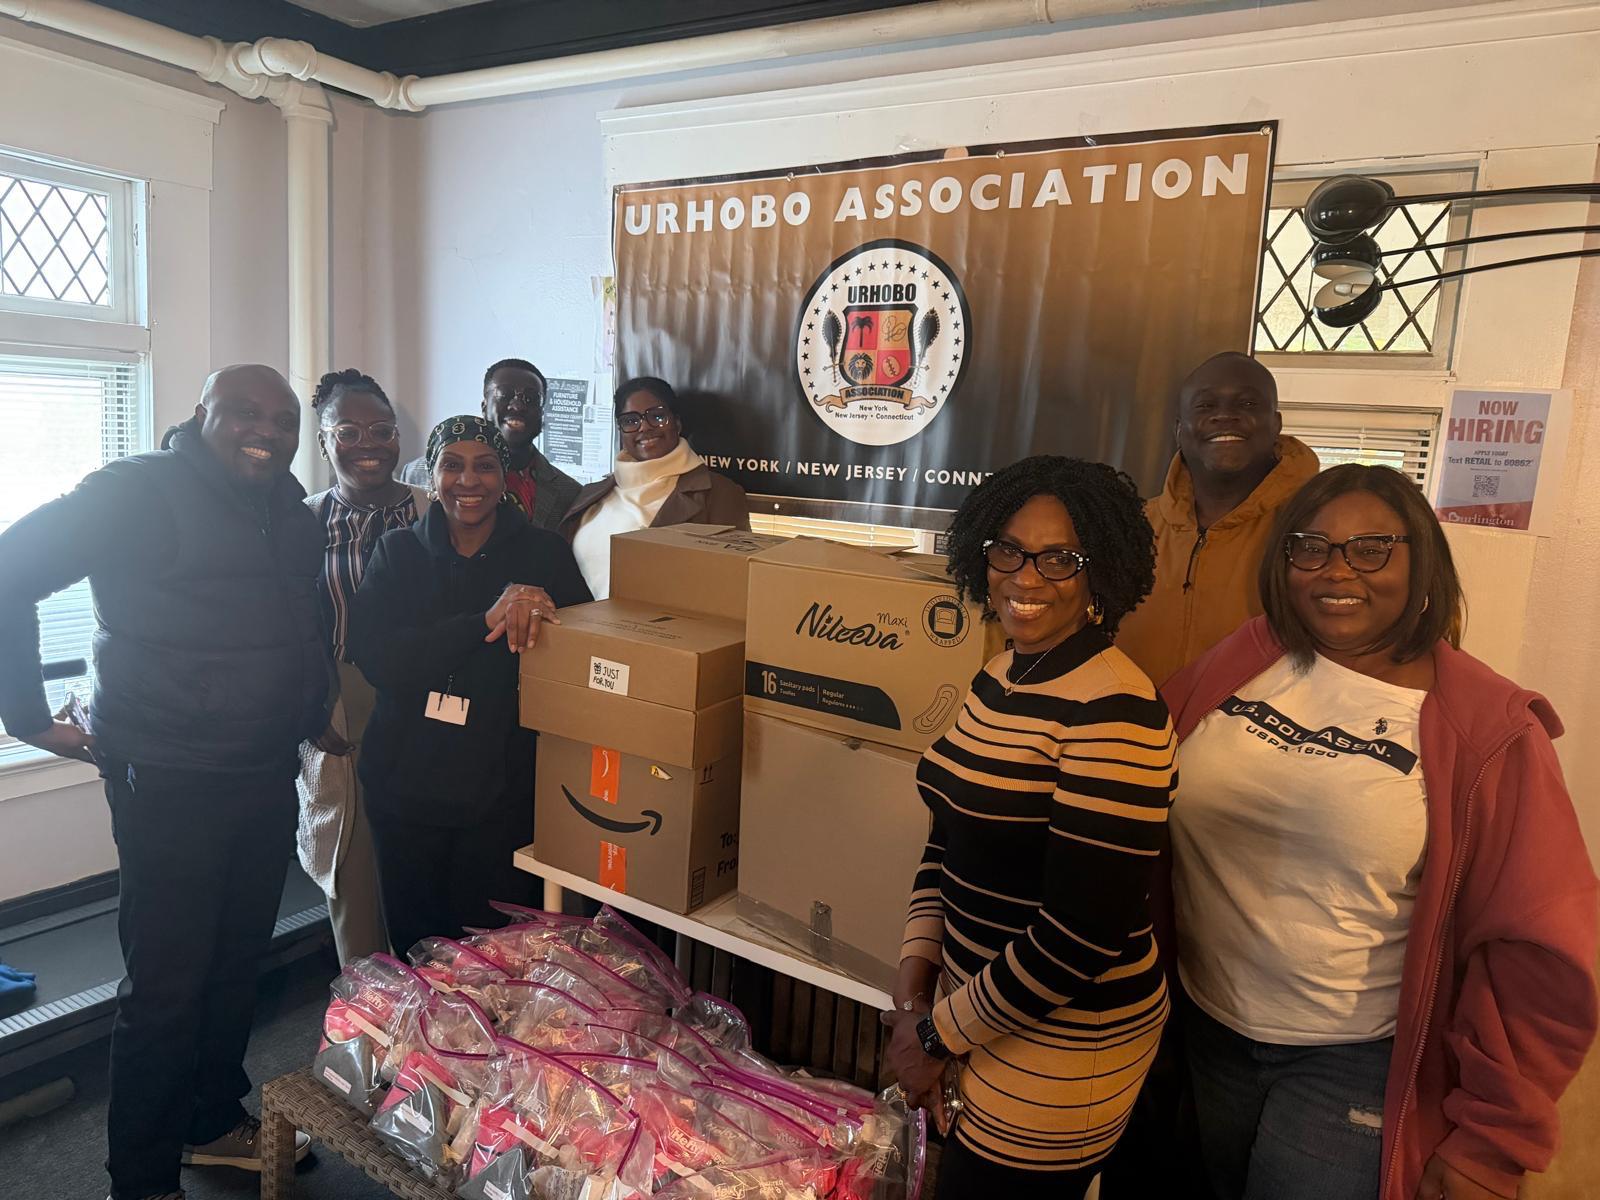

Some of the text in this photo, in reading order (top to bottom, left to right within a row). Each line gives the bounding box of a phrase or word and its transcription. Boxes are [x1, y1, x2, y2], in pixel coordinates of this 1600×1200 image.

[624, 153, 1249, 235] URHOBO ASSOCIATION
[848, 283, 917, 304] URHOBO
[845, 387, 905, 400] ASSOCIATION
[554, 399, 582, 407] HOUSEHOLD
[1478, 400, 1519, 416] NOW
[849, 412, 868, 420] Jersey
[1447, 418, 1544, 444] HIRING
[1448, 456, 1463, 464] Text
[1464, 457, 1492, 465] RETAIL
[699, 454, 731, 469] NEW
[736, 457, 780, 473] YORK
[796, 462, 840, 477] NEW
[845, 464, 907, 481] JERSEY
[924, 469, 994, 486] CONN
[1448, 512, 1514, 526] Burlington
[877, 612, 908, 627] Maxi
[930, 632, 961, 645] WRAPPED
[603, 666, 620, 680] JUST
[761, 670, 815, 694] 16 Sanitary pads
[822, 689, 844, 699] Regular
[1264, 714, 1313, 742] POL
[1246, 725, 1289, 752] USPA
[720, 832, 737, 848] To:
[717, 859, 737, 878] Fro
[361, 988, 385, 1011] Hefty
[671, 1129, 702, 1154] Hefty
